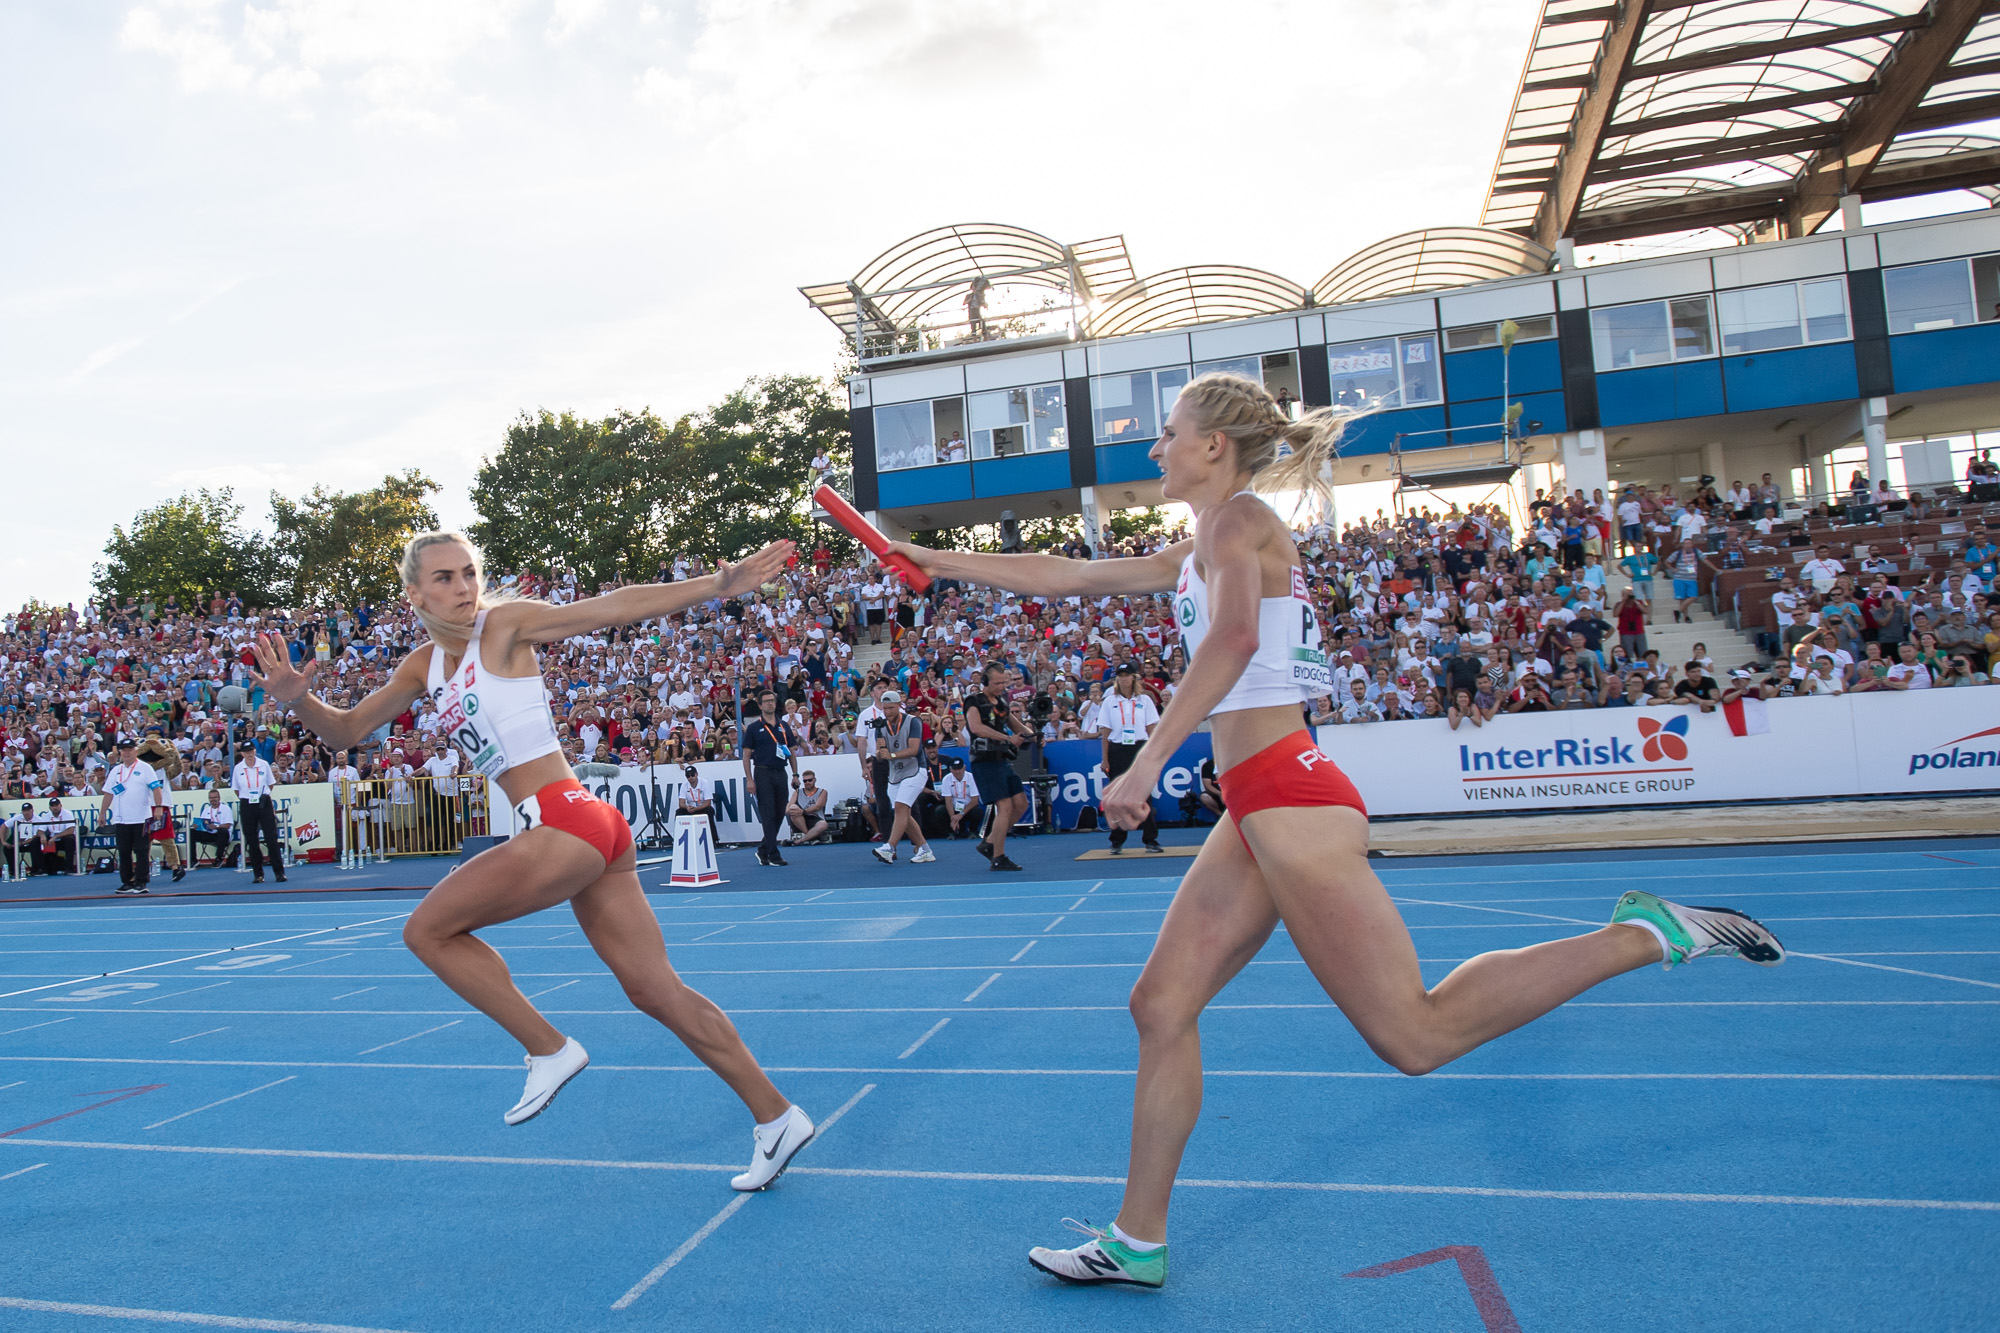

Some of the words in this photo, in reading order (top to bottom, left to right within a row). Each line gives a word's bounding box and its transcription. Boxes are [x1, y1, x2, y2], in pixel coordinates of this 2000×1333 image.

[439, 708, 464, 731] PAR
[893, 739, 900, 748] 6
[1460, 737, 1636, 771] InterRisk
[1908, 747, 2000, 775] polan
[1463, 786, 1527, 800] VIENNA
[1531, 782, 1630, 798] INSURANCE
[1635, 778, 1696, 793] GROUP
[24, 825, 29, 836] 4
